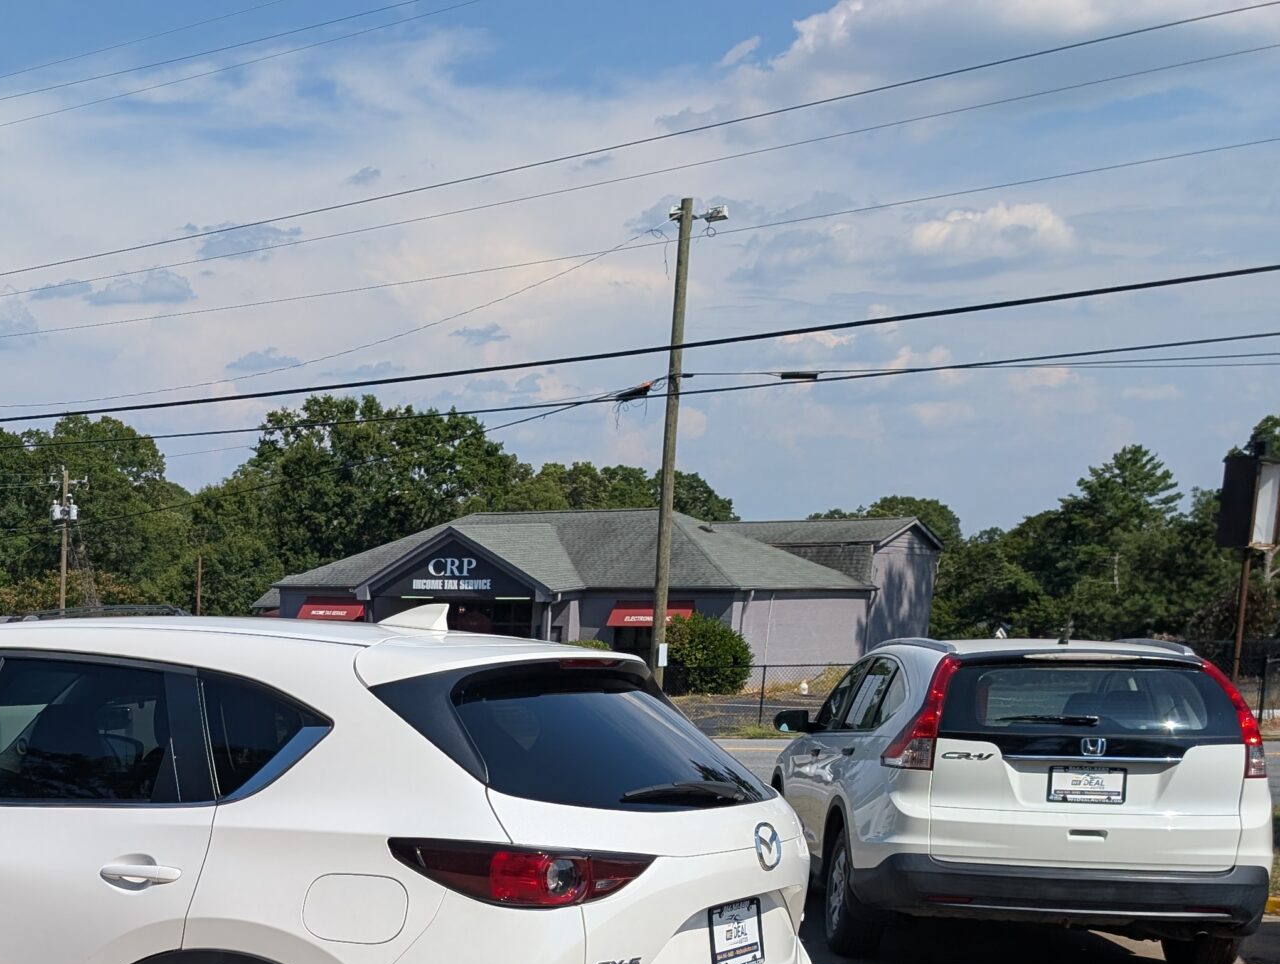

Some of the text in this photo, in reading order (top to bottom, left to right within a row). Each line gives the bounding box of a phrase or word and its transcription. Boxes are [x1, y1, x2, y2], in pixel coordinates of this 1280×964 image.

[428, 558, 476, 576] CRP
[412, 579, 491, 590] INCOME TAX SERVICE
[941, 751, 994, 760] CR-V
